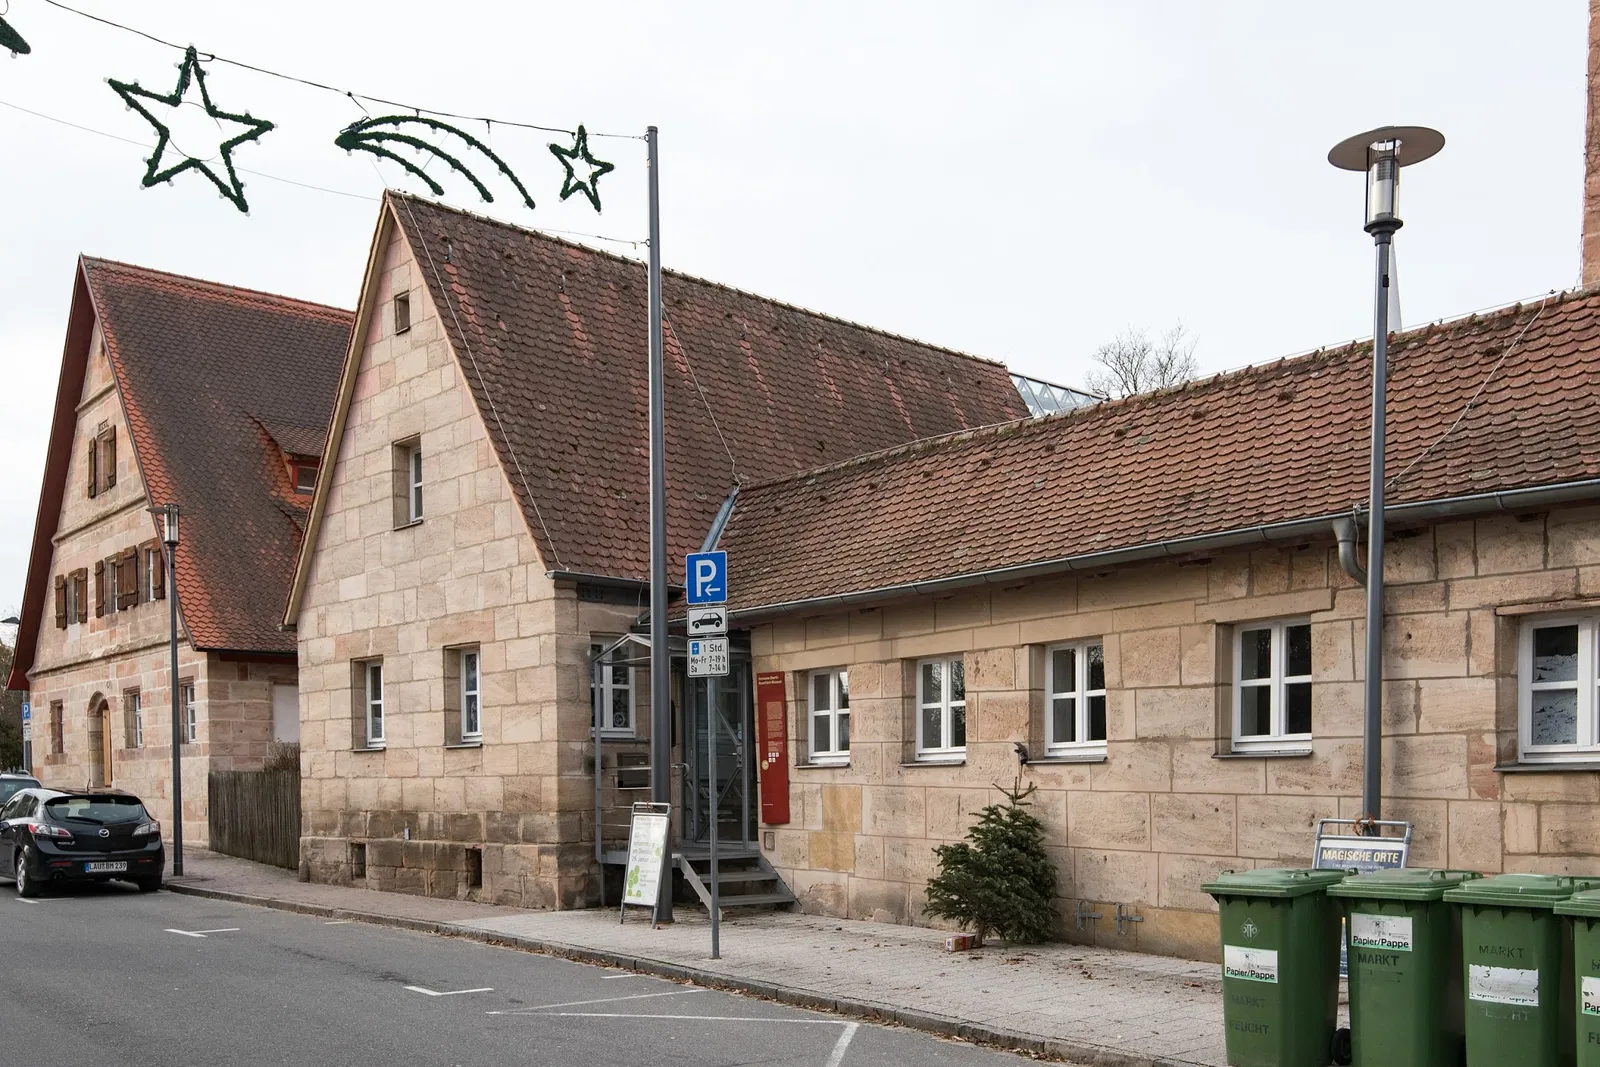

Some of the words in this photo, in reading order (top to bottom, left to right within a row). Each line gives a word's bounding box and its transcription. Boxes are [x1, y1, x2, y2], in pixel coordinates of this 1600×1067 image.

[695, 559, 717, 597] P
[703, 644, 706, 652] 1
[709, 643, 725, 652] Std.
[690, 655, 707, 665] Mo-Fr
[709, 655, 721, 663] 7-19
[690, 665, 698, 673] Sa
[709, 663, 721, 672] 7-14
[23, 704, 29, 718] P
[1321, 849, 1372, 862] MAGISCHE
[1373, 851, 1399, 863] ORTE
[114, 861, 127, 869] 239
[1353, 935, 1410, 949] Papier/Pappe
[1478, 945, 1525, 959] MARKT
[1357, 952, 1400, 967] MARKT
[1226, 966, 1275, 981] Papier/Pappe
[1229, 1020, 1269, 1035] FEUCHT
